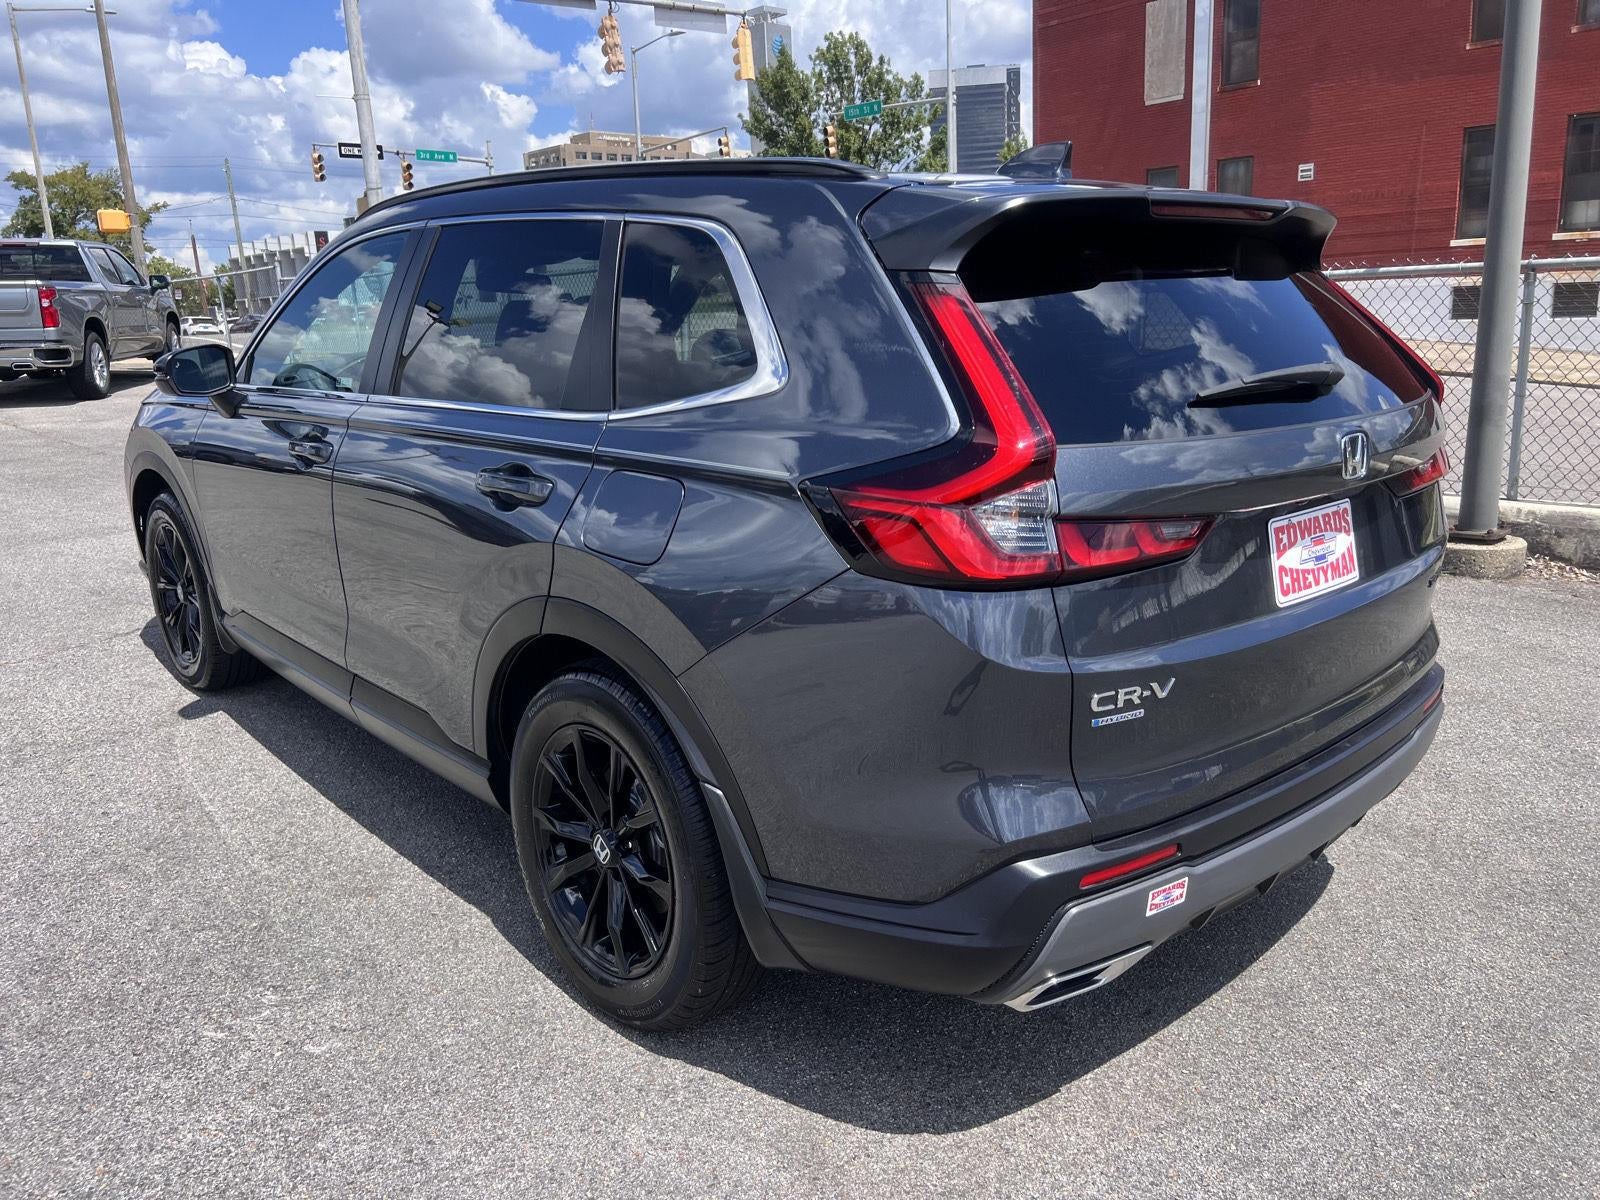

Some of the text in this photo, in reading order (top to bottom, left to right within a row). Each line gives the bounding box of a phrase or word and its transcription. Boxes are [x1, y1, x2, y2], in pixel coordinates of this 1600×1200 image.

[848, 108, 860, 117] 15th
[863, 106, 870, 114] St
[420, 151, 430, 159] 3rd
[434, 152, 445, 160] Ave
[1273, 507, 1351, 561] EDWARDS
[1307, 544, 1331, 557] Chevrolet
[1278, 541, 1356, 597] CHEVYMAN
[1091, 678, 1176, 712] CR-V
[1100, 710, 1144, 725] HYBRID
[1149, 891, 1184, 911] CHEVYMAN
[1151, 880, 1186, 902] EDWARDS
